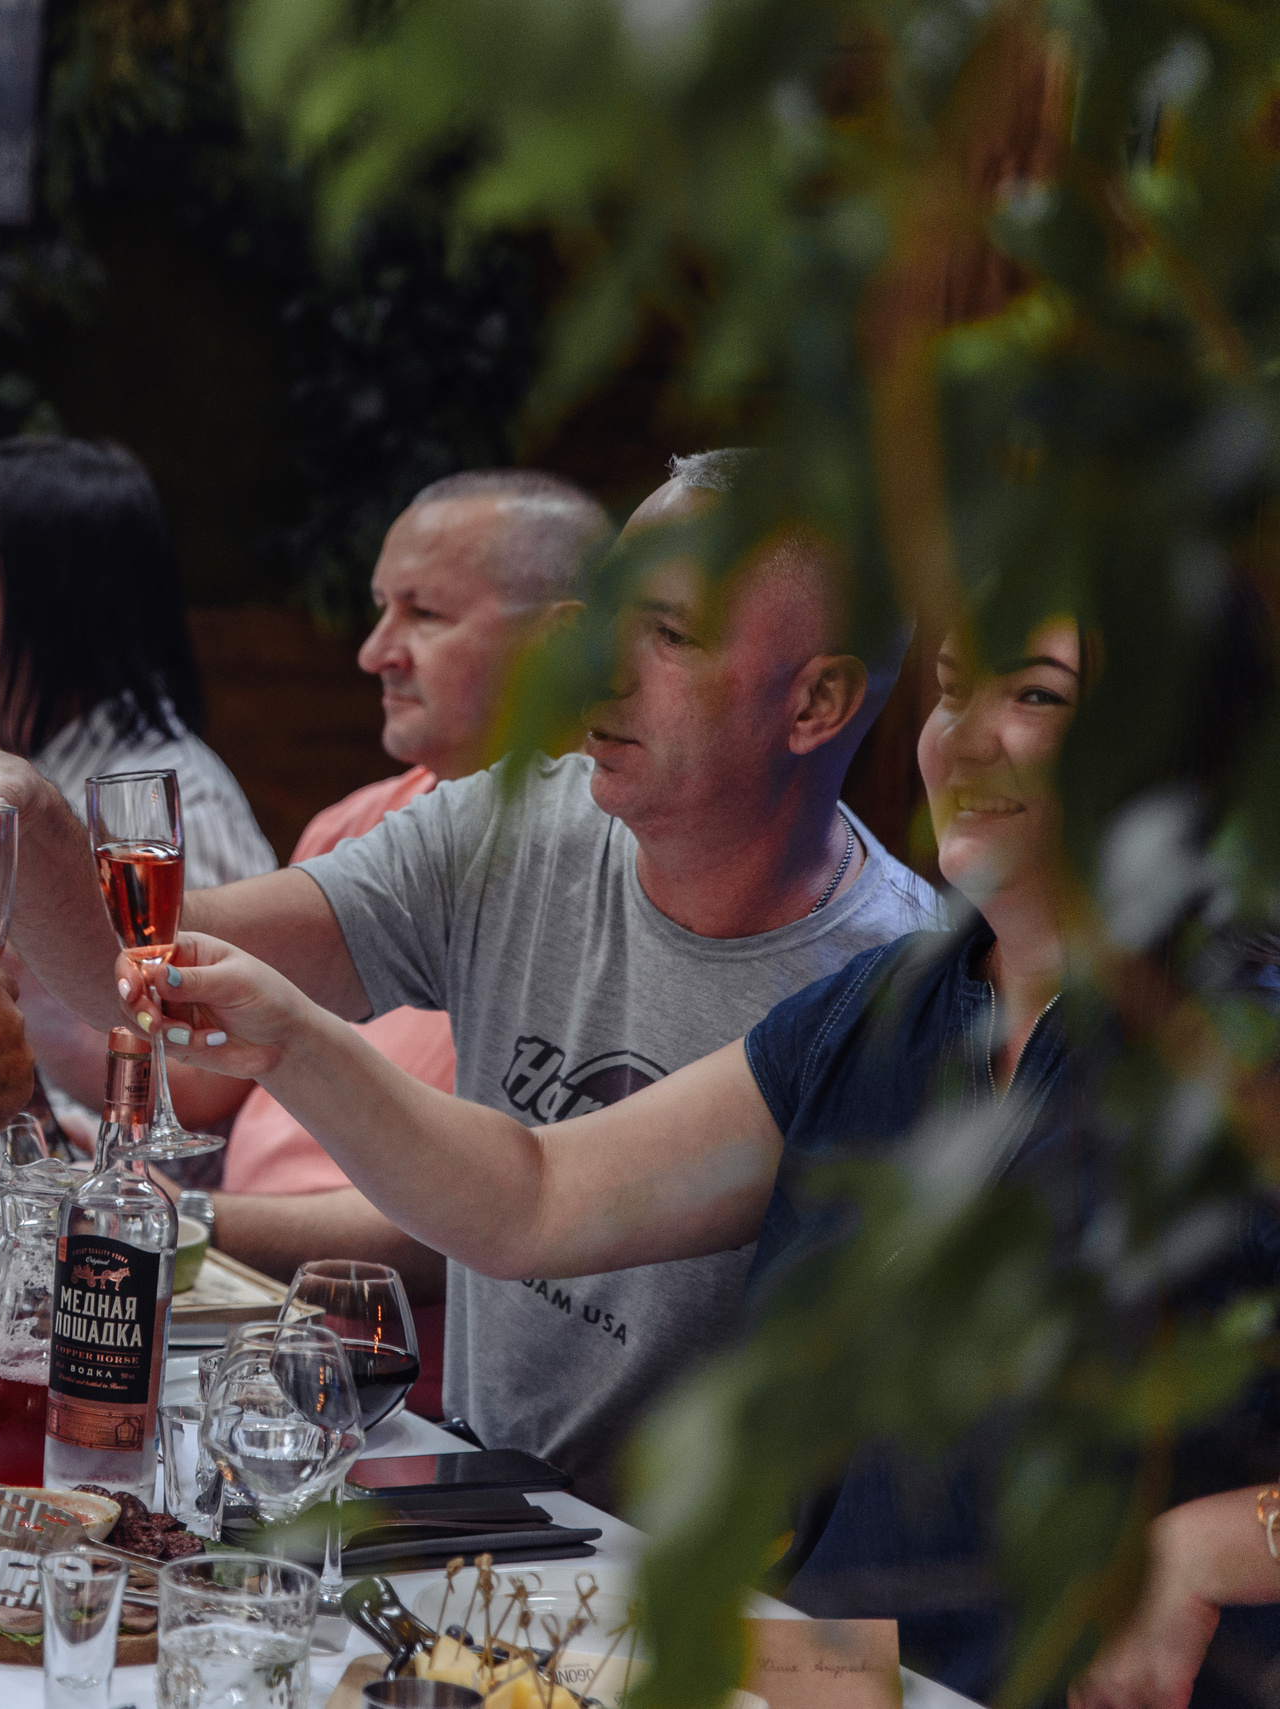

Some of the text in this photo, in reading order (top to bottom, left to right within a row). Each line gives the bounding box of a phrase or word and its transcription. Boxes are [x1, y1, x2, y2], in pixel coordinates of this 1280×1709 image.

[85, 1255, 111, 1266] Original
[88, 1247, 111, 1256] QUALITY
[111, 1252, 129, 1264] VODKA
[60, 1285, 138, 1320] МЕДНАЯ
[54, 1310, 142, 1347] ЛОШАДКА
[582, 1304, 627, 1346] USA
[55, 1344, 139, 1364] COPPER HORSE
[70, 1364, 113, 1379] ВОДКА
